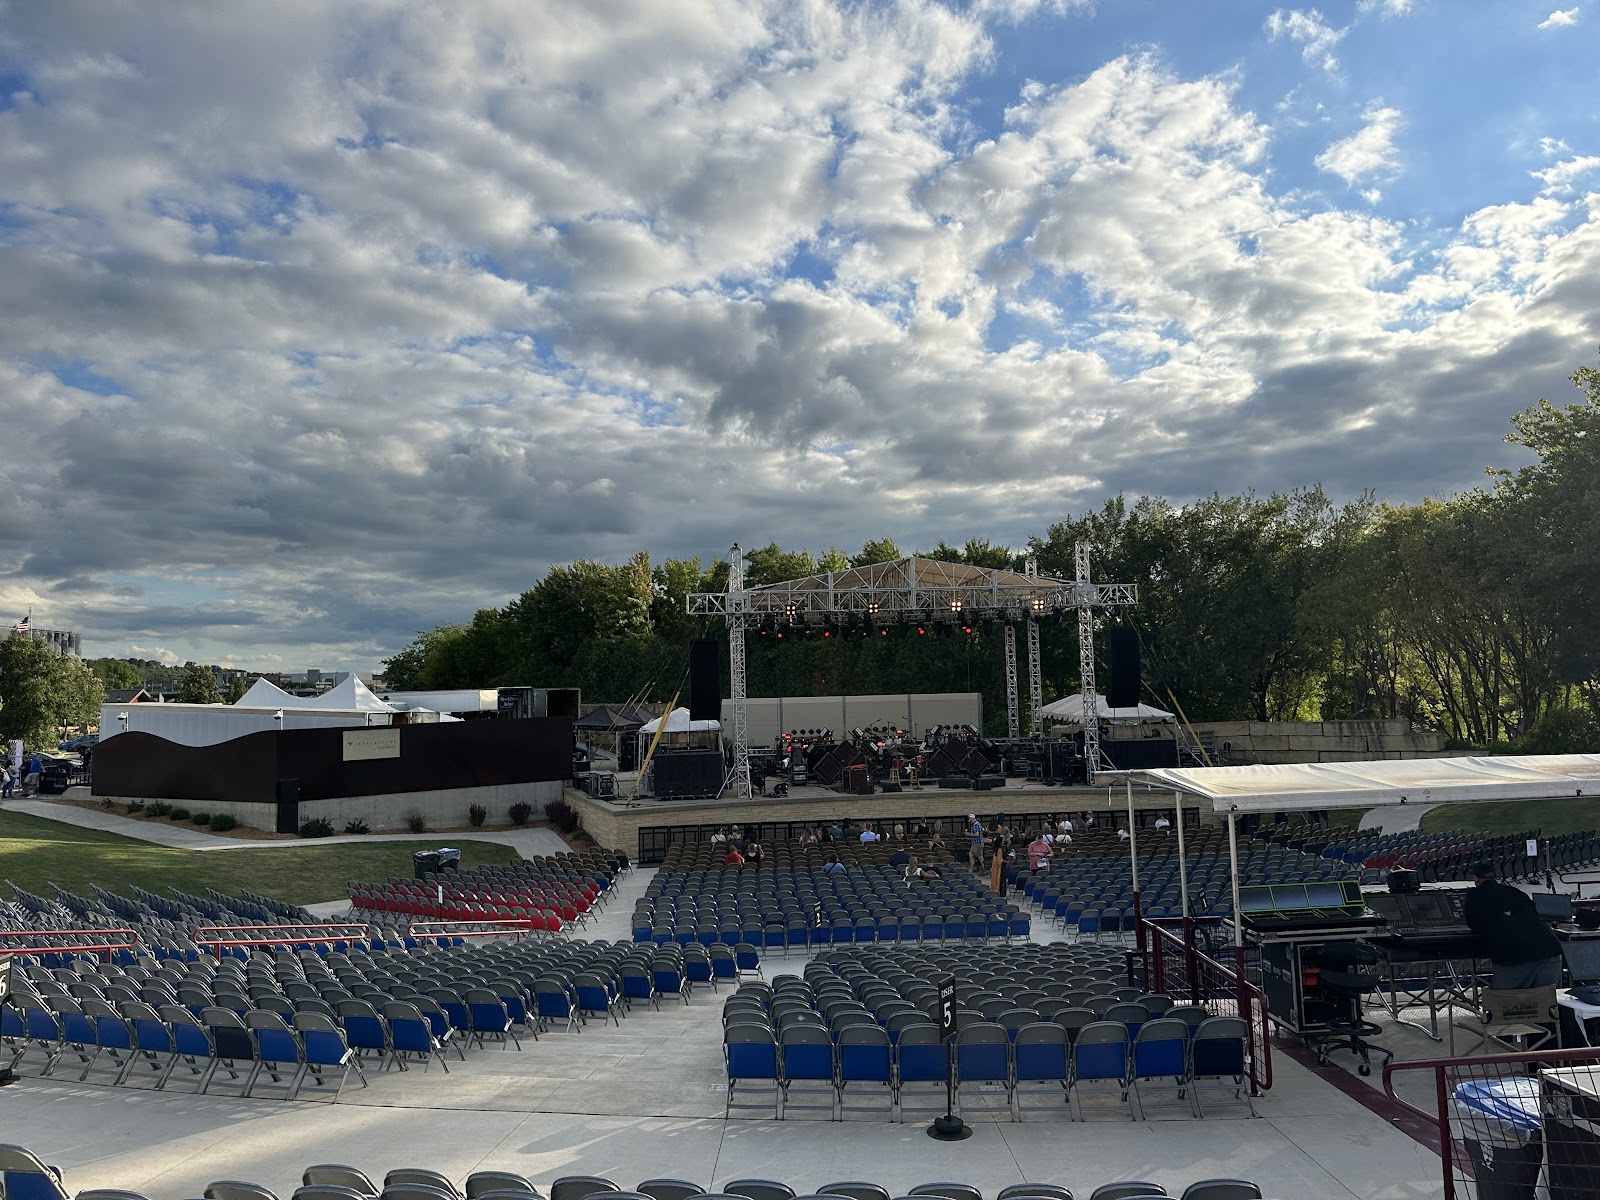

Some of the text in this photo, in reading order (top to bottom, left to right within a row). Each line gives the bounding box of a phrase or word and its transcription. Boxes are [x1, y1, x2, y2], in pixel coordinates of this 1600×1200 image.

[0, 974, 6, 997] 6
[941, 985, 954, 999] RISER
[943, 1001, 952, 1028] 5
